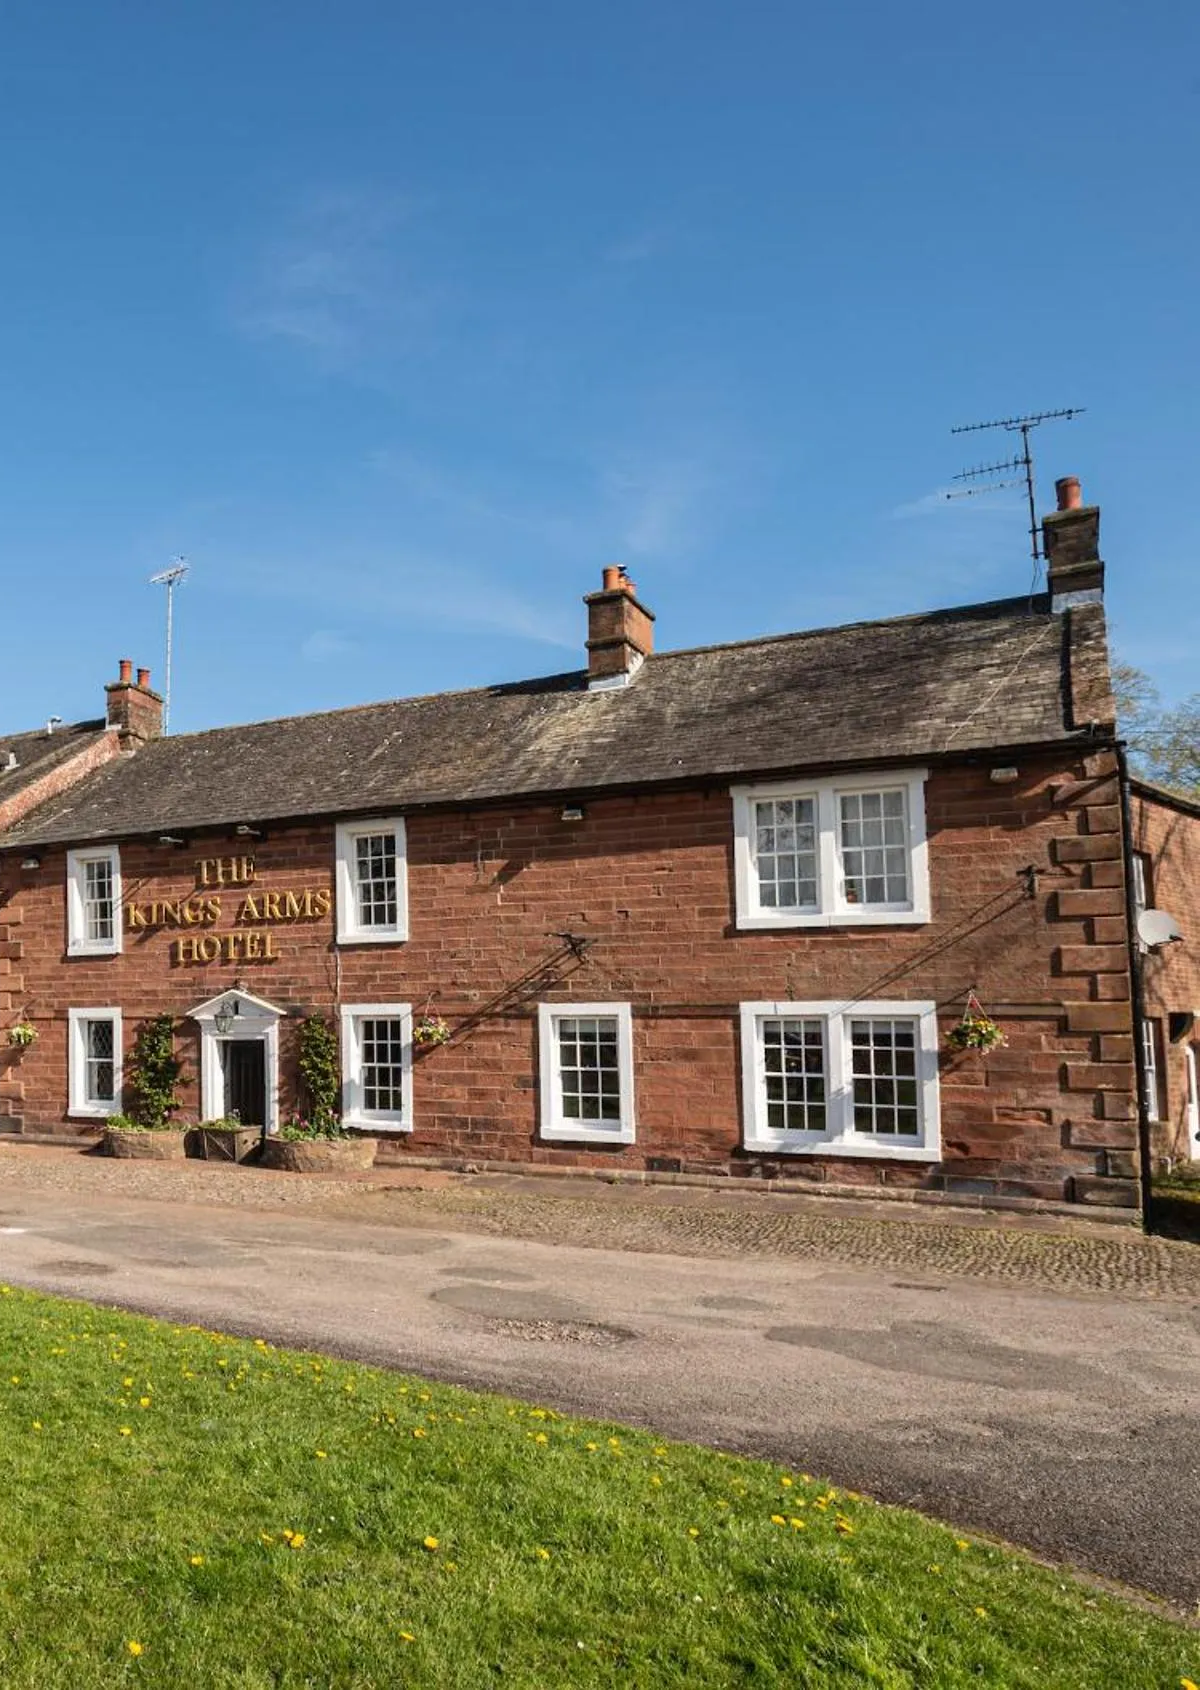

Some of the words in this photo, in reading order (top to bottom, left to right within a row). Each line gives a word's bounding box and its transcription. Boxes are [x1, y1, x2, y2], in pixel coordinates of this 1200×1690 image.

[196, 856, 259, 885] THE
[127, 896, 222, 926] KINGS
[240, 889, 331, 920] ARMS
[177, 931, 280, 962] HOTEL
